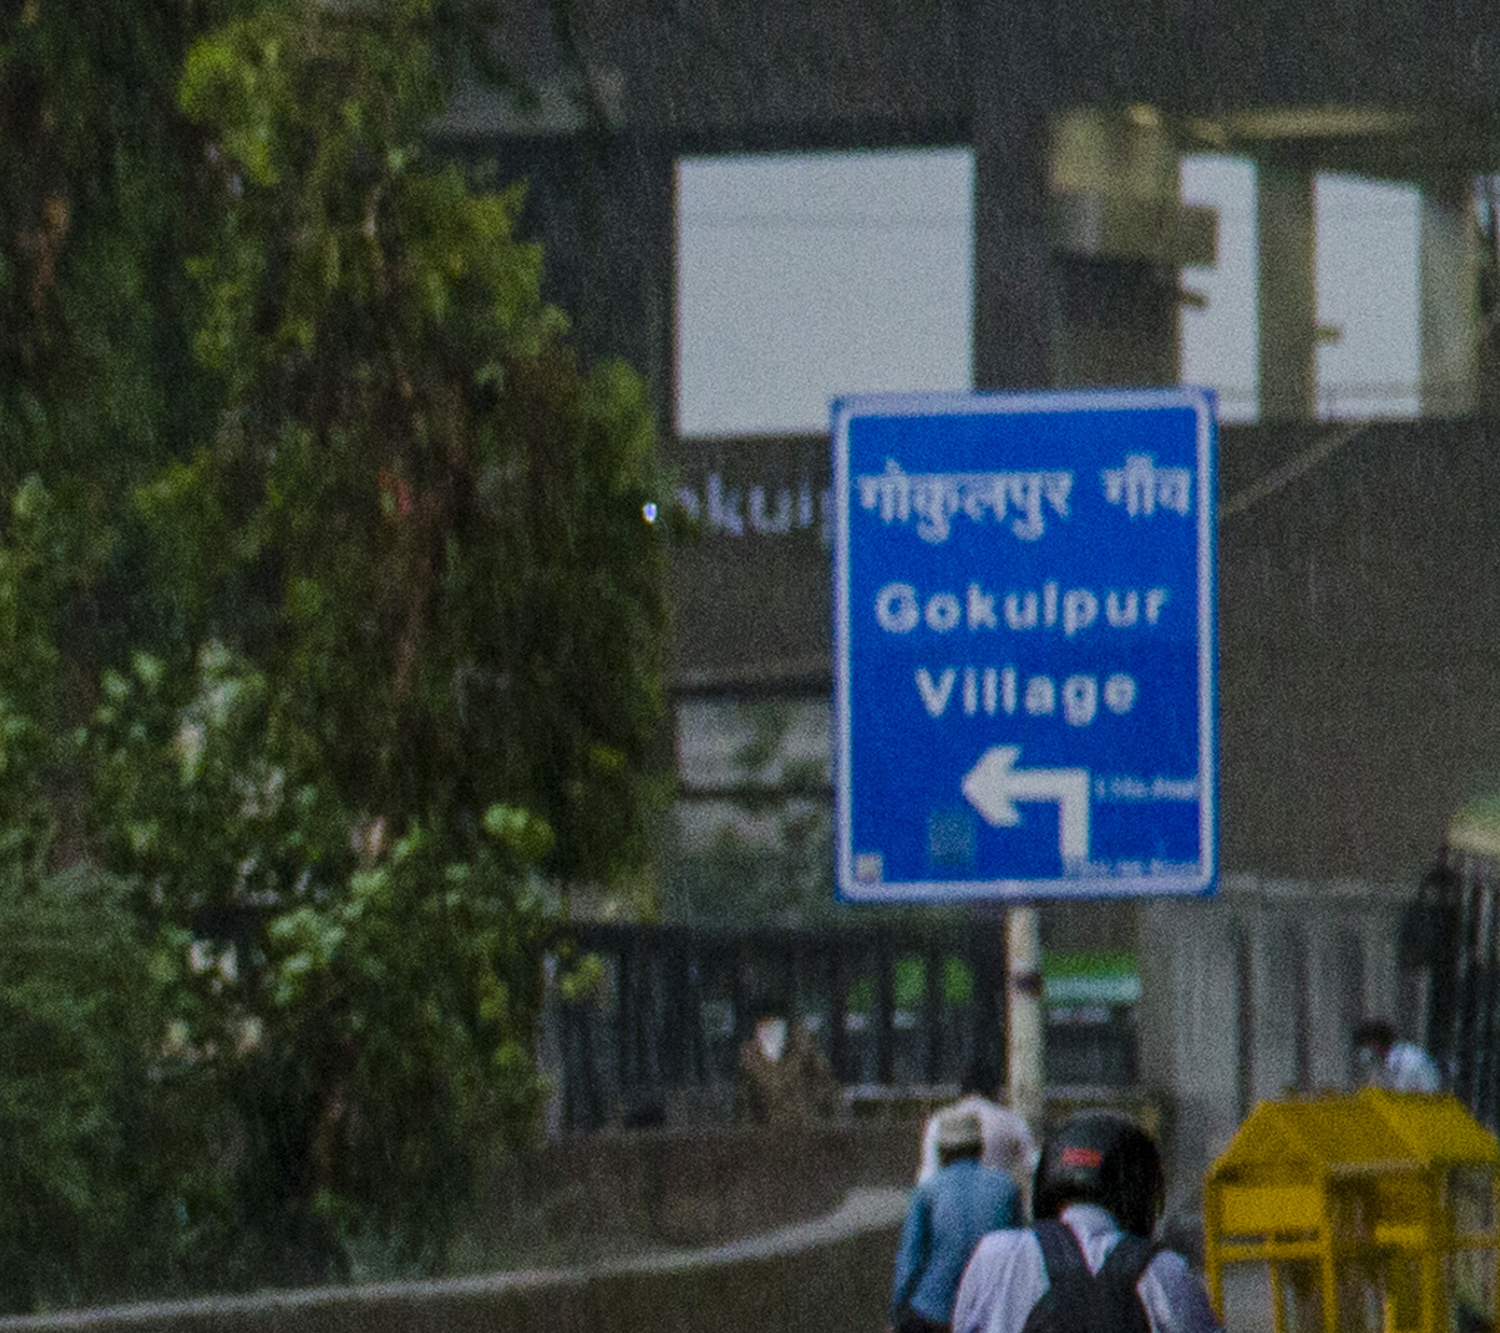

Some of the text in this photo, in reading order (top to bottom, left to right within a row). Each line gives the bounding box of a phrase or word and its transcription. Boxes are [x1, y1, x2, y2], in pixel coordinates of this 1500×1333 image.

[856, 457, 1072, 544] गोकुलपुर
[874, 581, 1168, 638] Gokulpur
[914, 665, 1138, 727] Village
